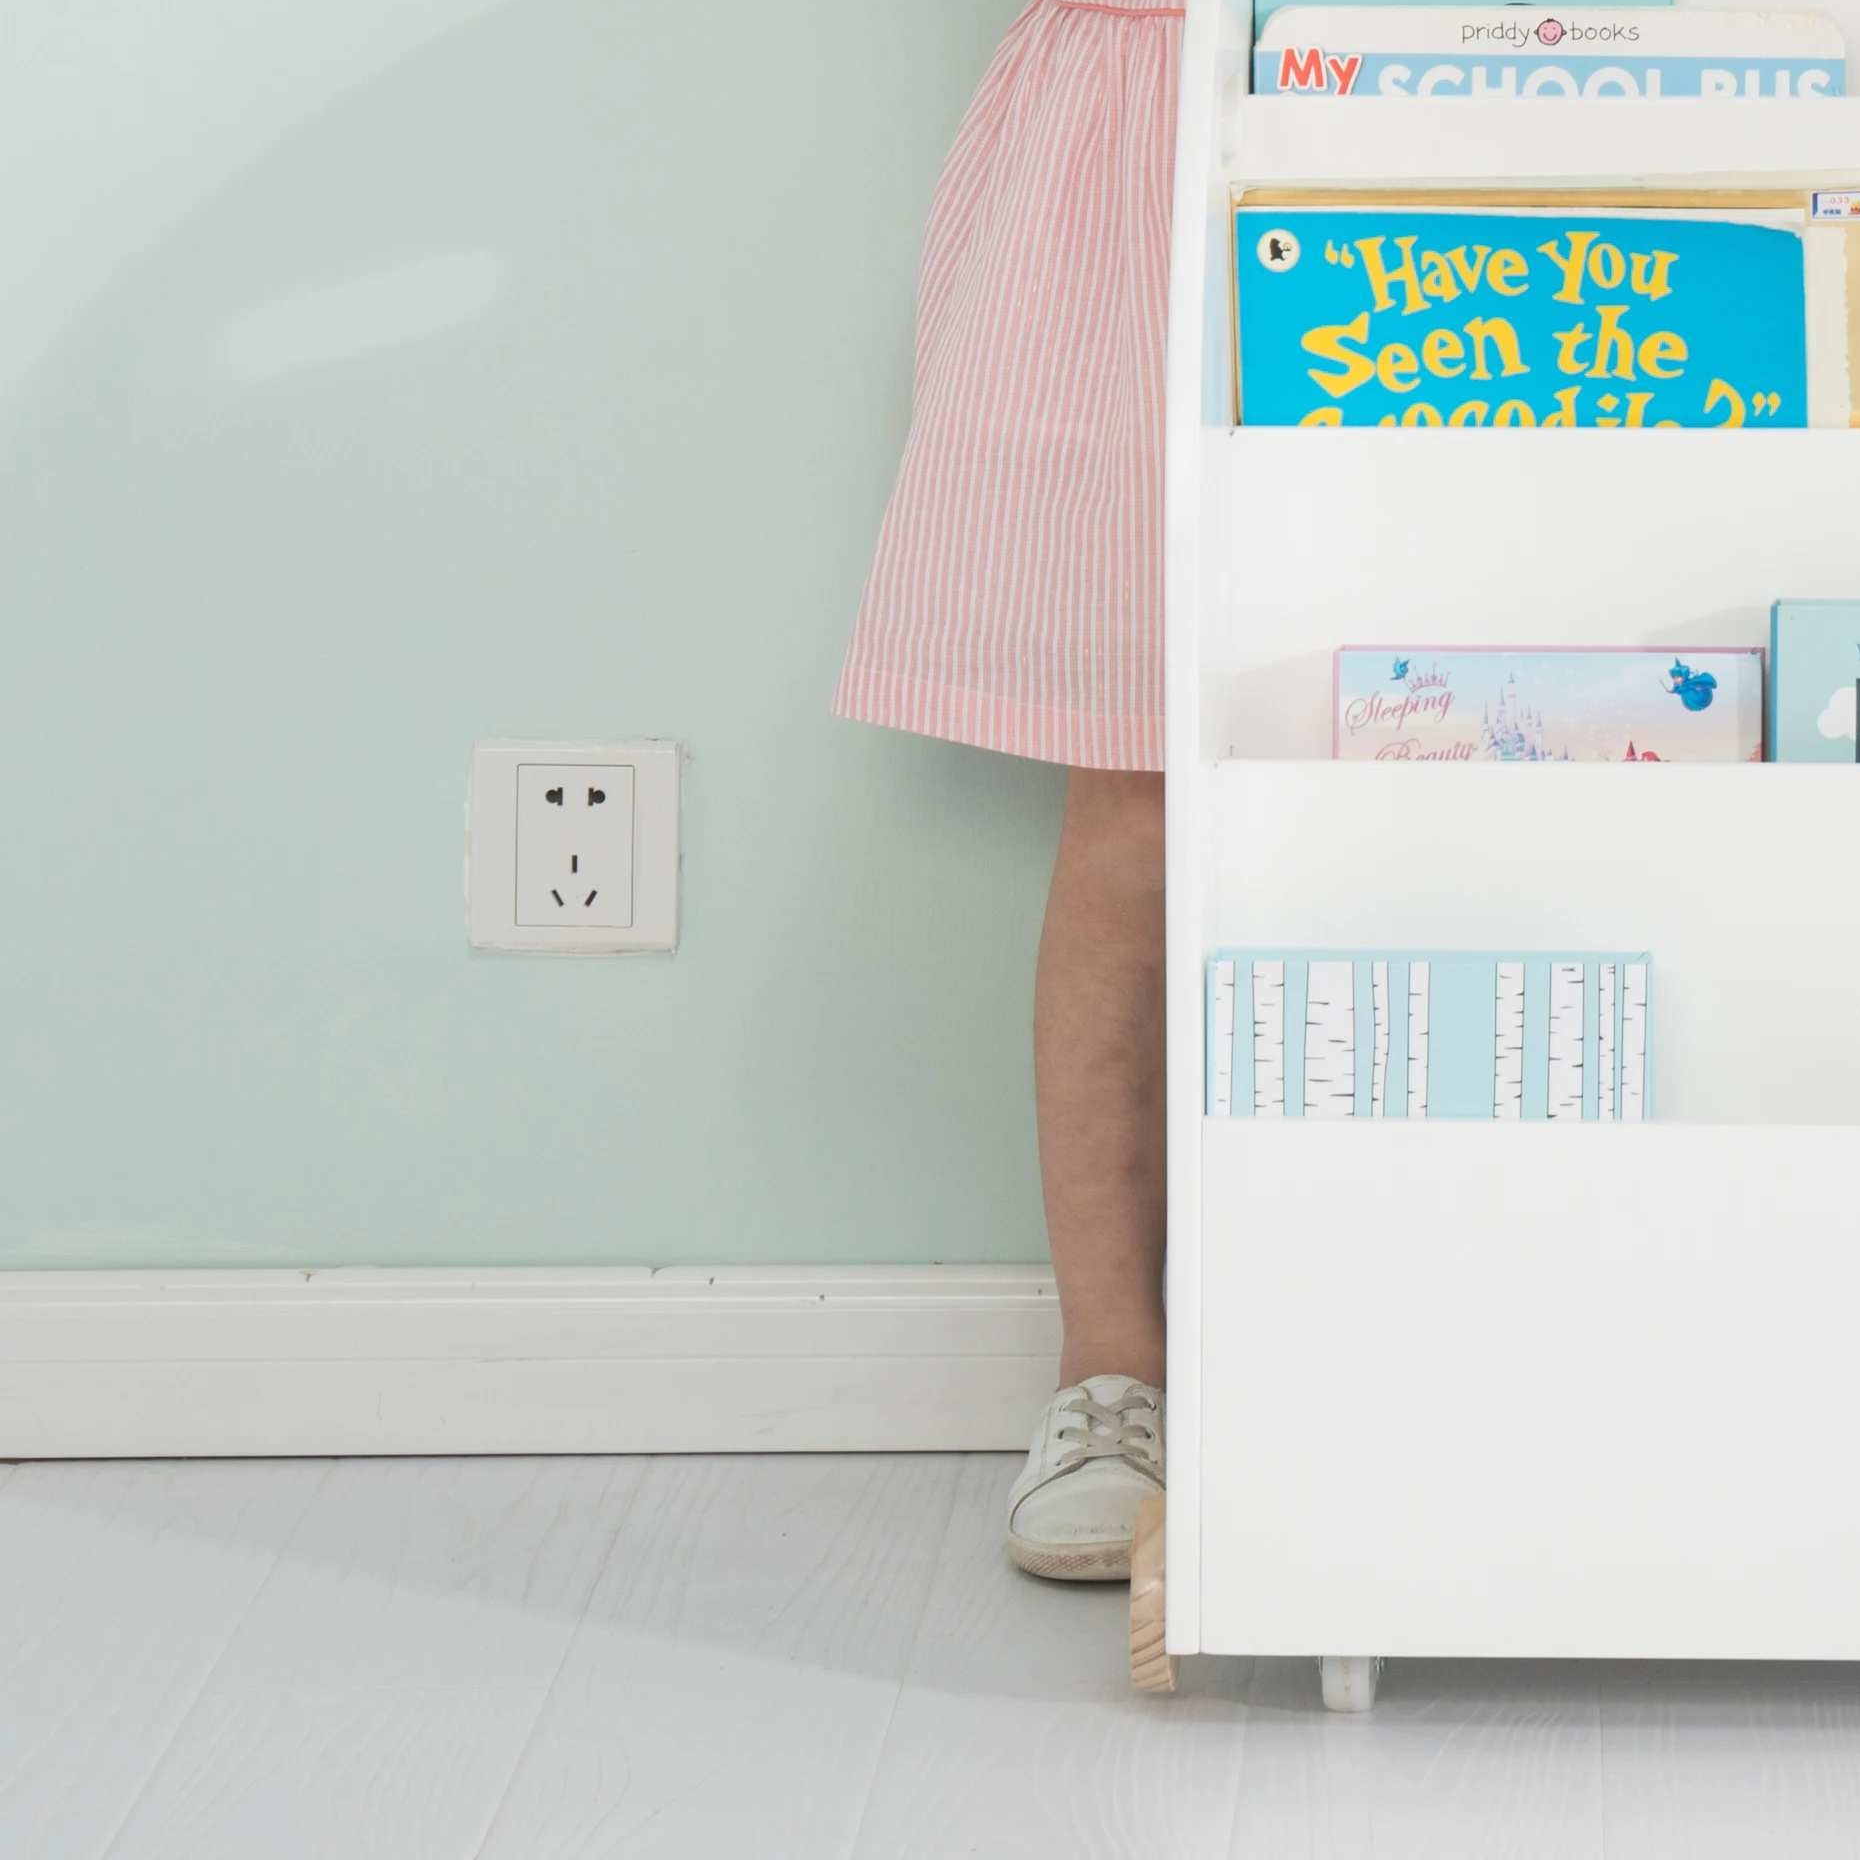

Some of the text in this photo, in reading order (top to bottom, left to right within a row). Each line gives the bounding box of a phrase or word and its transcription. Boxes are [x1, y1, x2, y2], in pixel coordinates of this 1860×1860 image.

[1461, 21, 1640, 48] priddy books
[1280, 47, 1359, 96] My
[1536, 231, 1680, 305] You
[1301, 305, 1689, 399] Seen the
[1345, 690, 1456, 737] Sleeping
